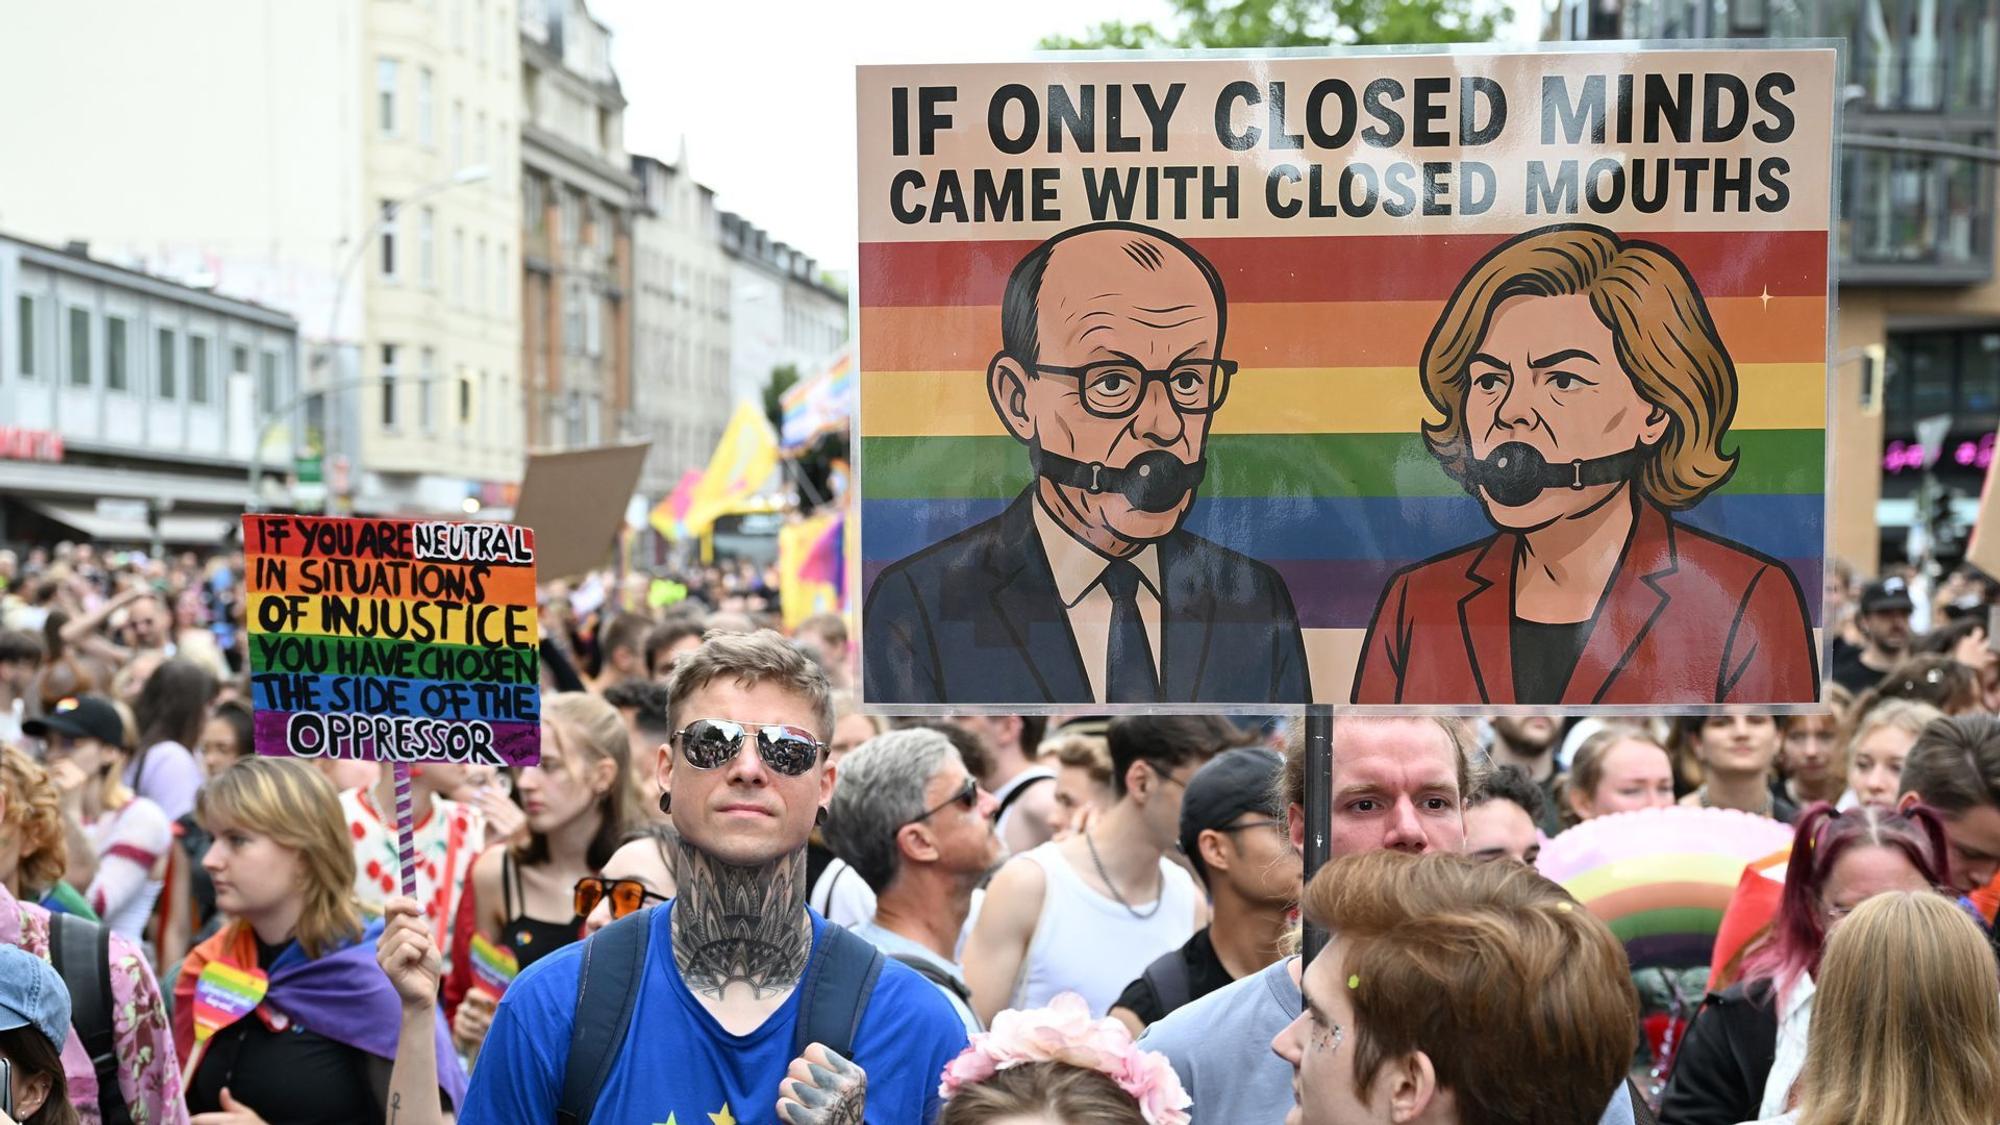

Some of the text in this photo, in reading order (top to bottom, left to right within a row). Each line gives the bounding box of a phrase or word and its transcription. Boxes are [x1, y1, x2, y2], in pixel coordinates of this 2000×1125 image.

[892, 72, 1796, 156] IF ONLY CLOSED MINDS
[890, 157, 1791, 224] CAME WITH CLOSED MOUTHS
[258, 518, 534, 562] IF YOU ARE NEUTRAL
[256, 557, 491, 604] IN SITUATIONS
[258, 595, 310, 633] OF
[257, 634, 537, 685] YOU HAVE CHOSEN
[251, 673, 539, 720] THE SIDE OF THE
[287, 711, 508, 766] OPPRESSOR
